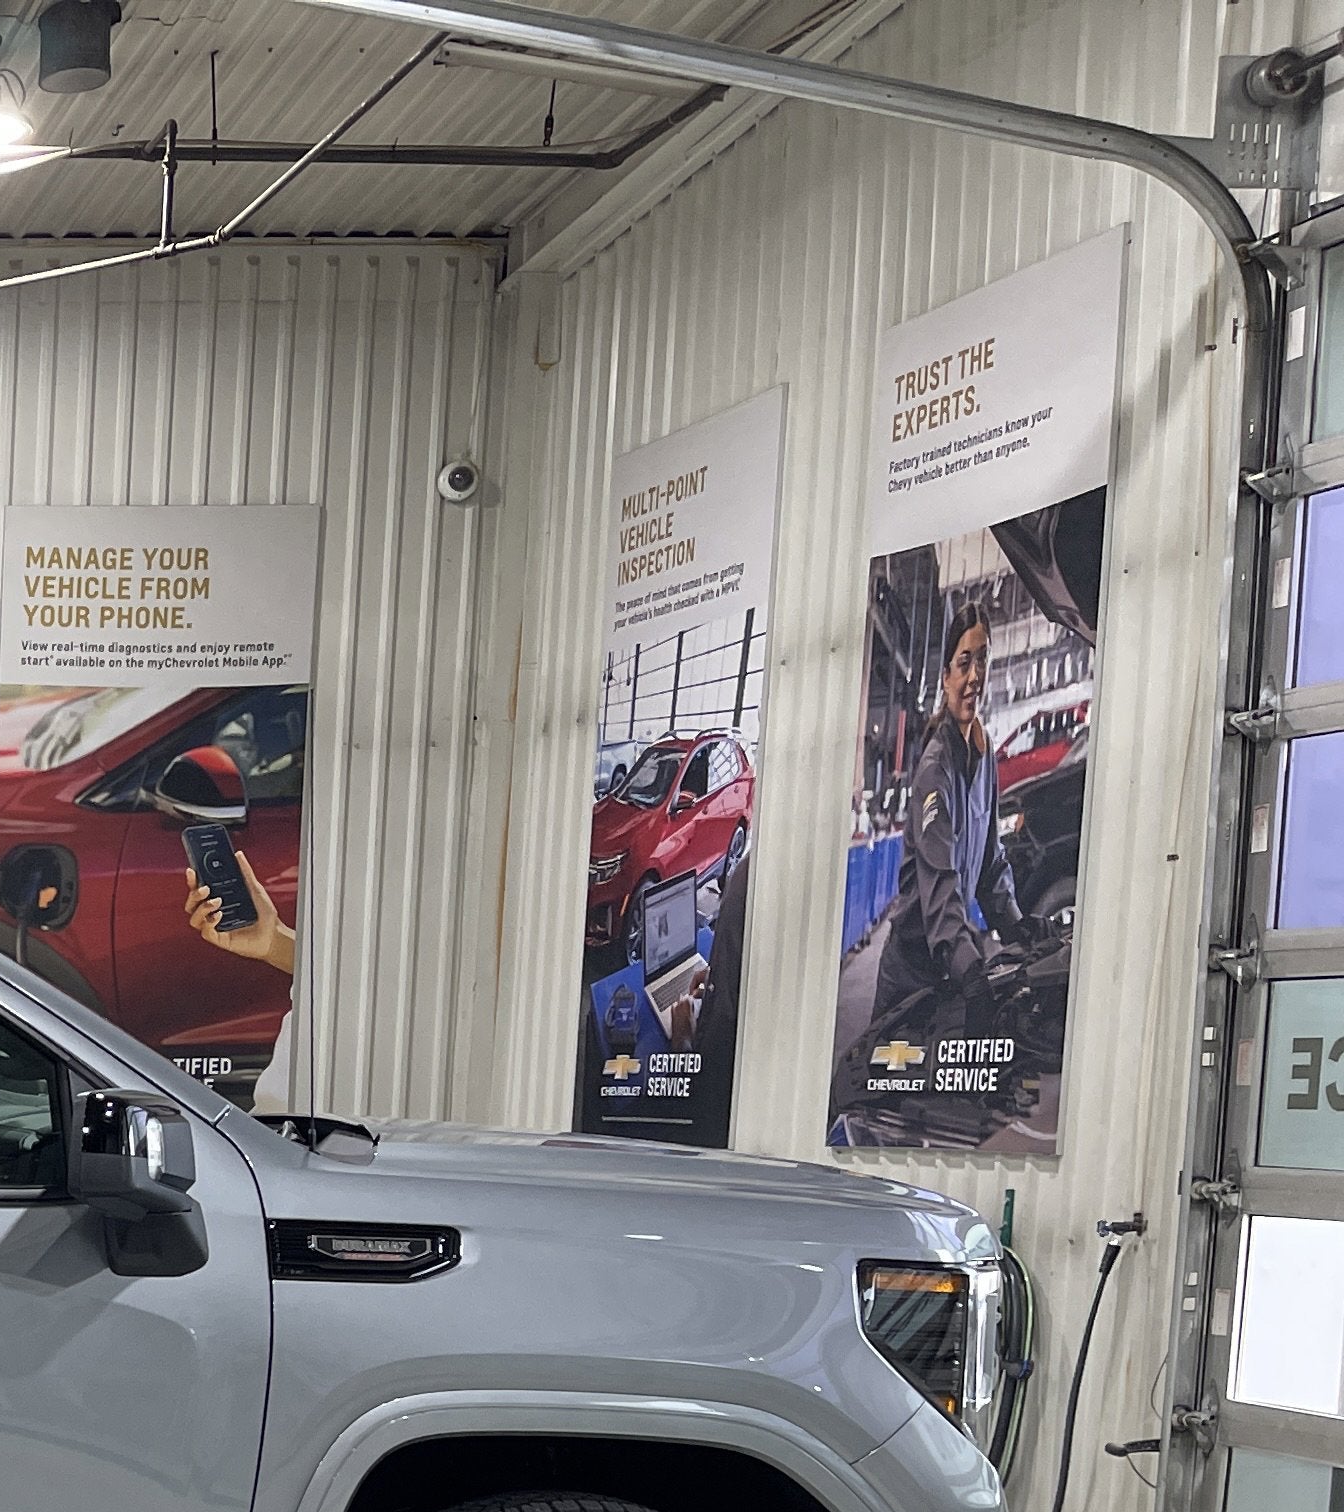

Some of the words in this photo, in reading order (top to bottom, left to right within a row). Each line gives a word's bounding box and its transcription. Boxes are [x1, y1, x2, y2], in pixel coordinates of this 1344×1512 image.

[895, 355, 952, 404] TRUST
[958, 338, 995, 379] THE
[892, 385, 980, 442] EXPERTS.
[889, 456, 919, 474] Factory
[922, 442, 952, 463] trained
[954, 426, 1002, 452] technicians
[1005, 415, 1029, 433] know
[1031, 407, 1052, 428] your
[888, 477, 912, 493] Chevy
[914, 465, 942, 485] vehicle
[945, 455, 972, 475] better
[974, 448, 993, 465] than
[995, 436, 1030, 458] anyone.
[621, 466, 708, 522] MULTI-POINT
[620, 512, 674, 553] VEHICLE
[26, 546, 134, 570] MANAGE
[143, 548, 209, 571] YOUR
[618, 537, 695, 587] INSPECTION
[25, 576, 131, 600] VEHICLE
[140, 577, 210, 600] FROM
[23, 605, 90, 628] YOUR
[100, 606, 192, 629] PHONE.
[21, 640, 48, 652] View
[52, 641, 104, 653] real-time
[109, 641, 172, 655] diagnostics
[177, 642, 196, 654] and
[201, 642, 230, 655] enjoy
[234, 642, 274, 652] remote
[56, 656, 105, 668] available
[109, 658, 121, 668] on
[126, 657, 144, 668] the
[147, 657, 218, 670] myChevrolet
[222, 656, 258, 668] Mobile
[938, 1039, 1014, 1063] CERTIFIED
[173, 1057, 232, 1075] TIFIED
[650, 1054, 701, 1073] CERTIFIED
[600, 1086, 641, 1096] CHEVROLET
[648, 1077, 690, 1097] SERVICE
[867, 1079, 925, 1091] CHEVROLET
[935, 1068, 999, 1092] SERVICE
